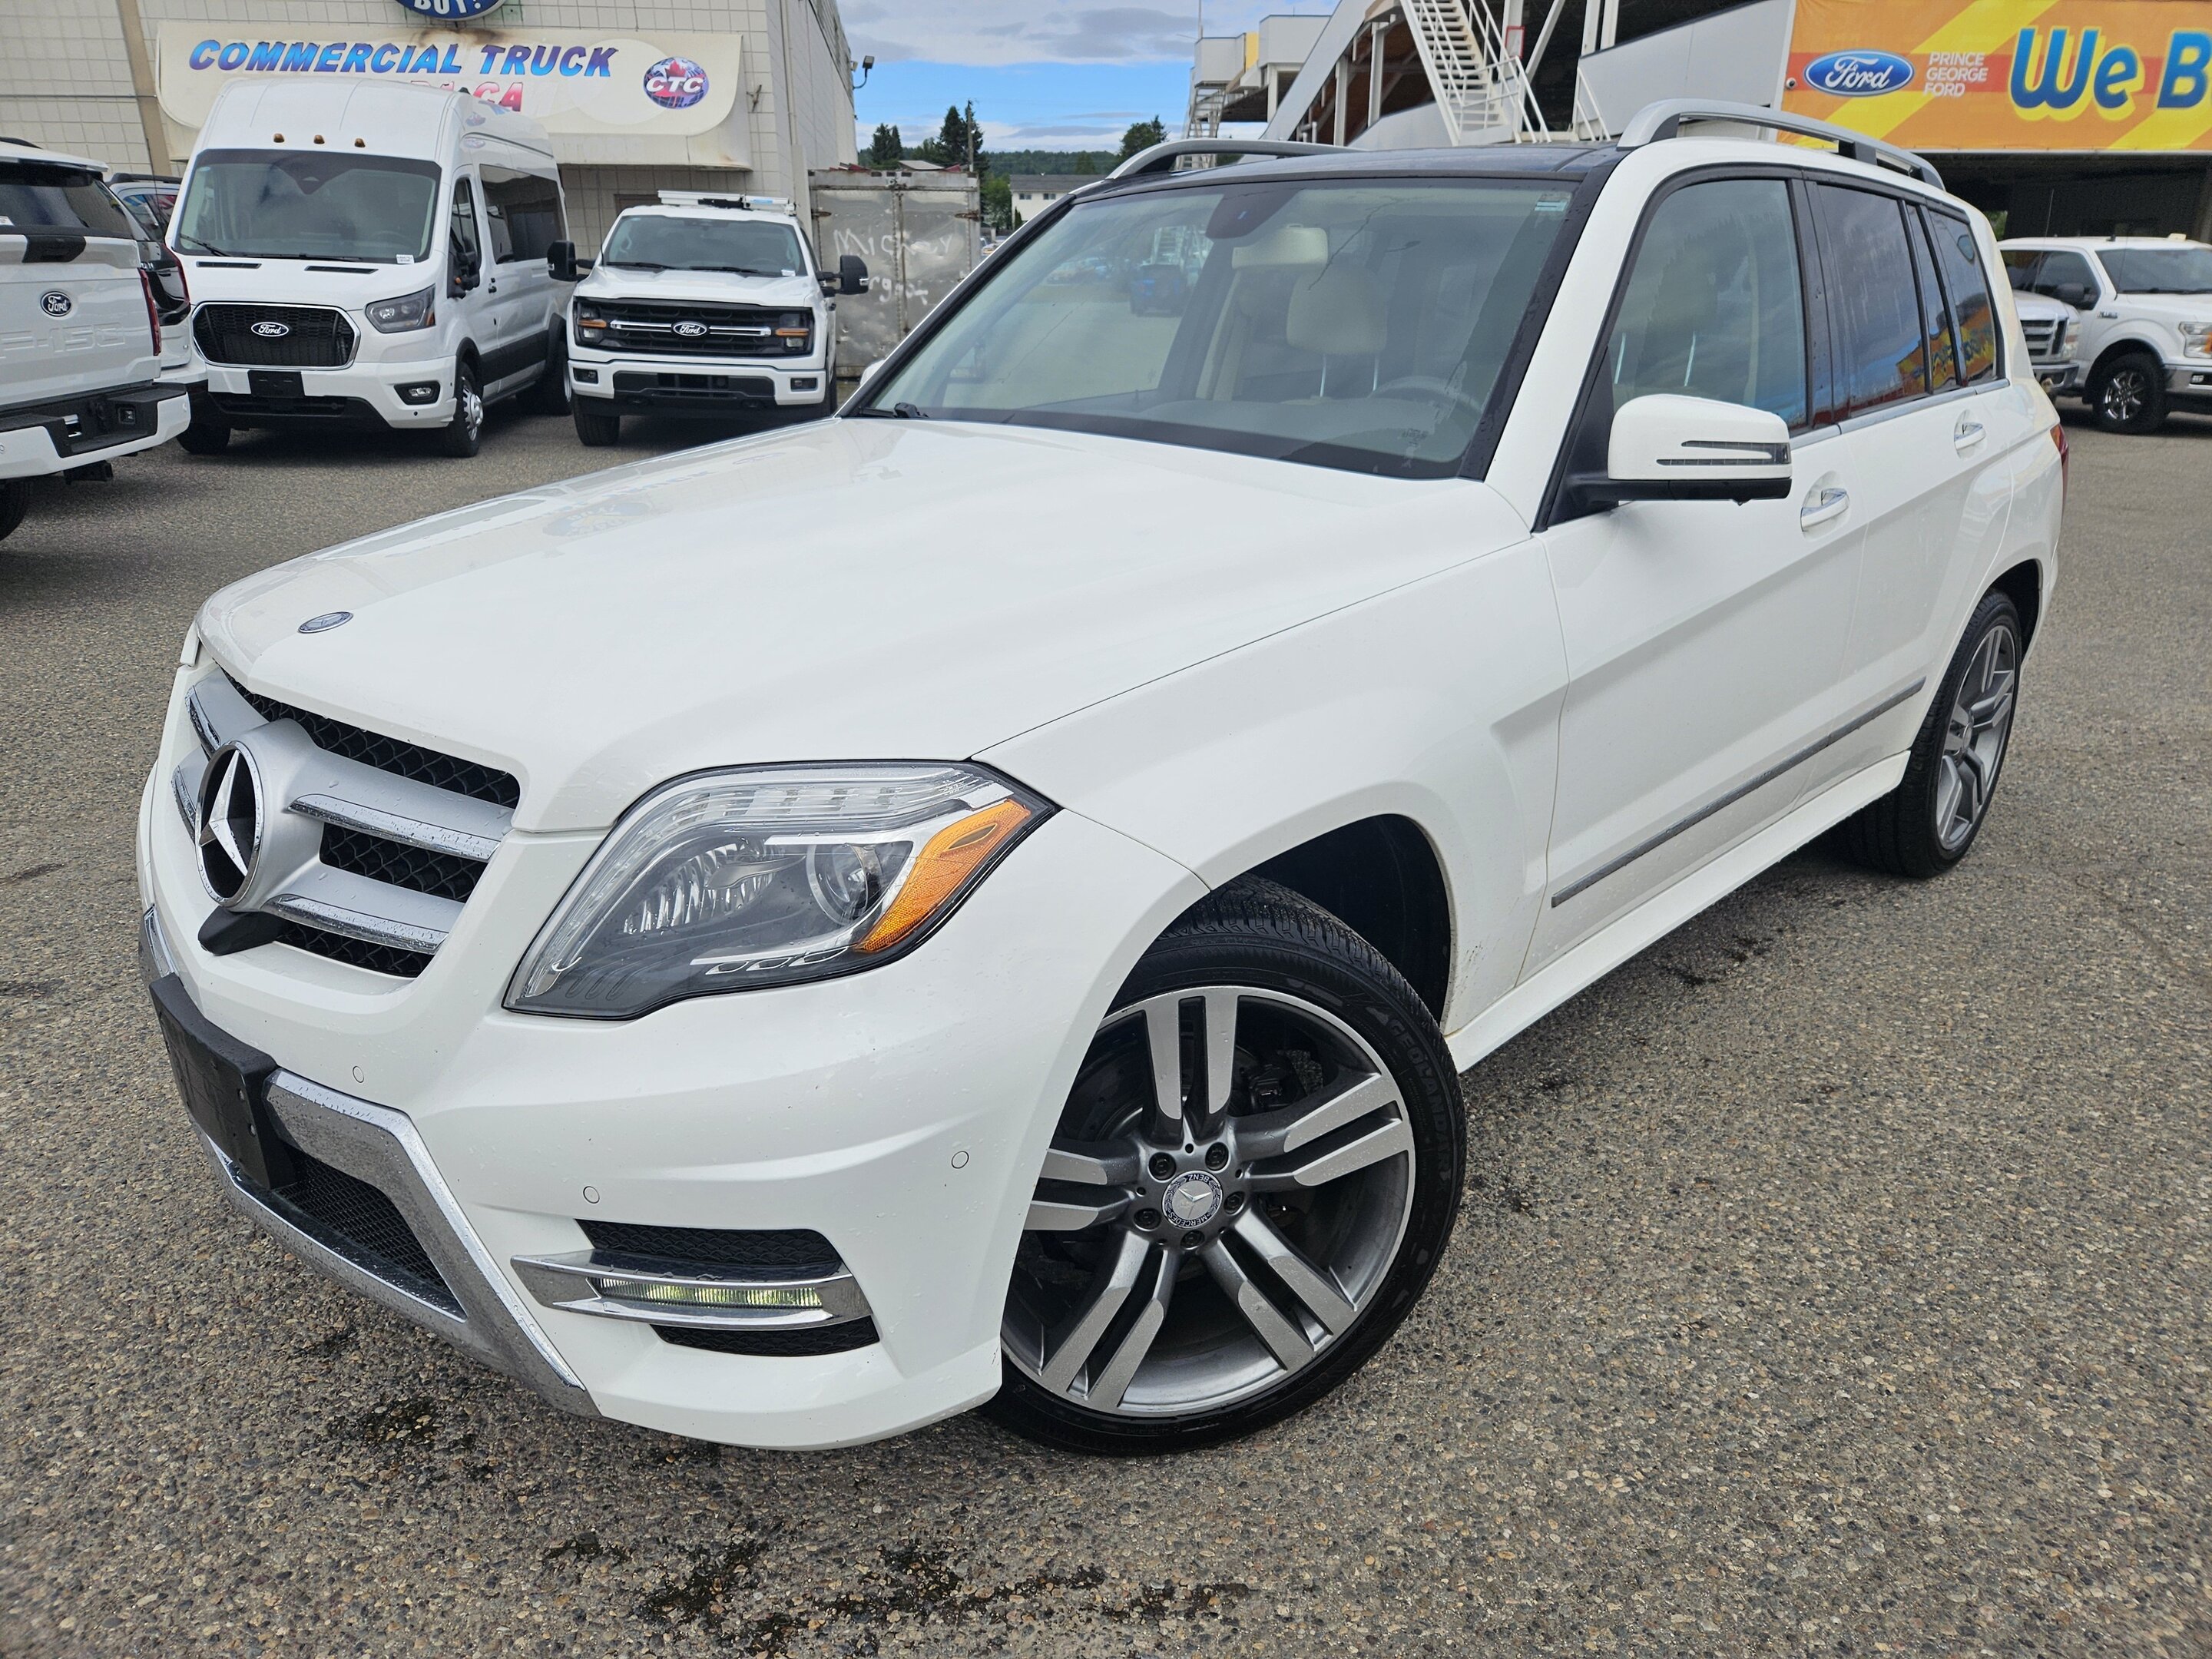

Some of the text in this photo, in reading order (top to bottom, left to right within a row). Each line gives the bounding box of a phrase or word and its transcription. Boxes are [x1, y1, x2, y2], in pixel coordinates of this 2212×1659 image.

[189, 39, 619, 78] COMMERCIAL TRUCK
[1929, 51, 1985, 67] PRINCE
[1824, 56, 1894, 89] Ford
[1926, 67, 1989, 83] GEORGE
[2009, 26, 2140, 112] We
[646, 75, 704, 94] CTC
[1923, 81, 1966, 98] FORD
[47, 295, 68, 313] Ford
[257, 323, 282, 335] Ford
[679, 323, 701, 335] Ford
[1187, 1174, 1210, 1184] BENZ
[1168, 1211, 1208, 1227] MERCEDES
